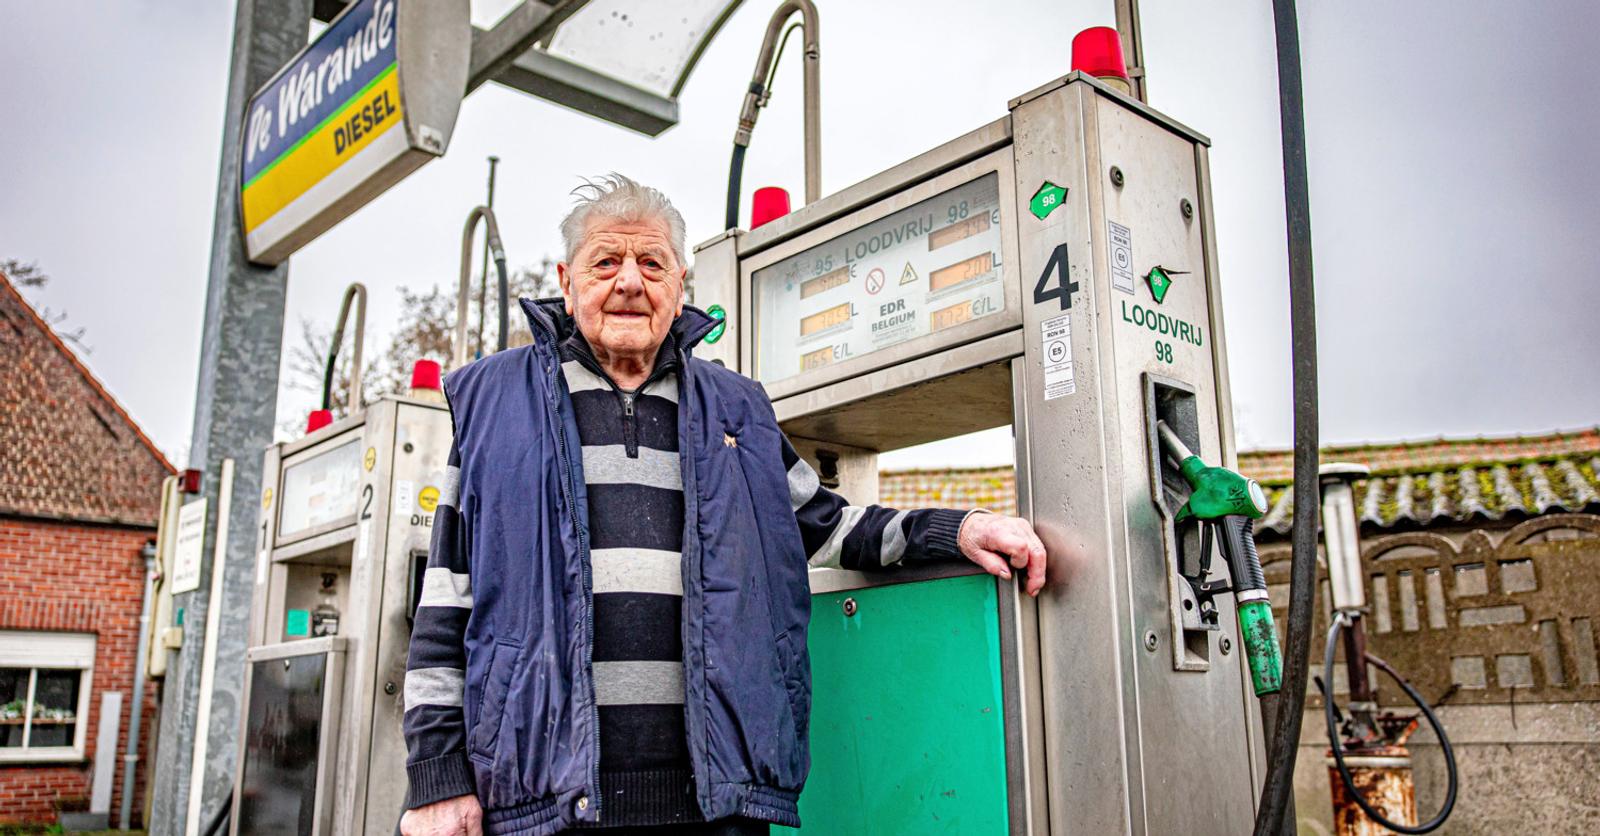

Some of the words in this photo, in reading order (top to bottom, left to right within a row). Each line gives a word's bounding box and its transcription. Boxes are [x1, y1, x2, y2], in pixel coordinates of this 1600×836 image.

[247, 104, 272, 163] De
[277, 0, 395, 138] Warande
[334, 90, 396, 155] DIESEL
[1042, 193, 1056, 207] 98
[815, 255, 833, 276] 95
[844, 213, 934, 264] LOODVRIJ
[946, 201, 969, 224] 98
[992, 253, 1002, 268] L
[1033, 242, 1079, 311] 4
[1152, 274, 1162, 287] 98
[851, 303, 858, 316] L
[880, 298, 906, 317] EDR
[871, 310, 916, 332] BELGIUM
[1121, 300, 1202, 347] LOODVRIJ
[1047, 330, 1058, 338] RON
[1052, 347, 1062, 356] E5
[1155, 340, 1174, 364] 98
[361, 483, 374, 520] 2
[410, 514, 432, 528] DIE
[262, 519, 268, 550] 1
